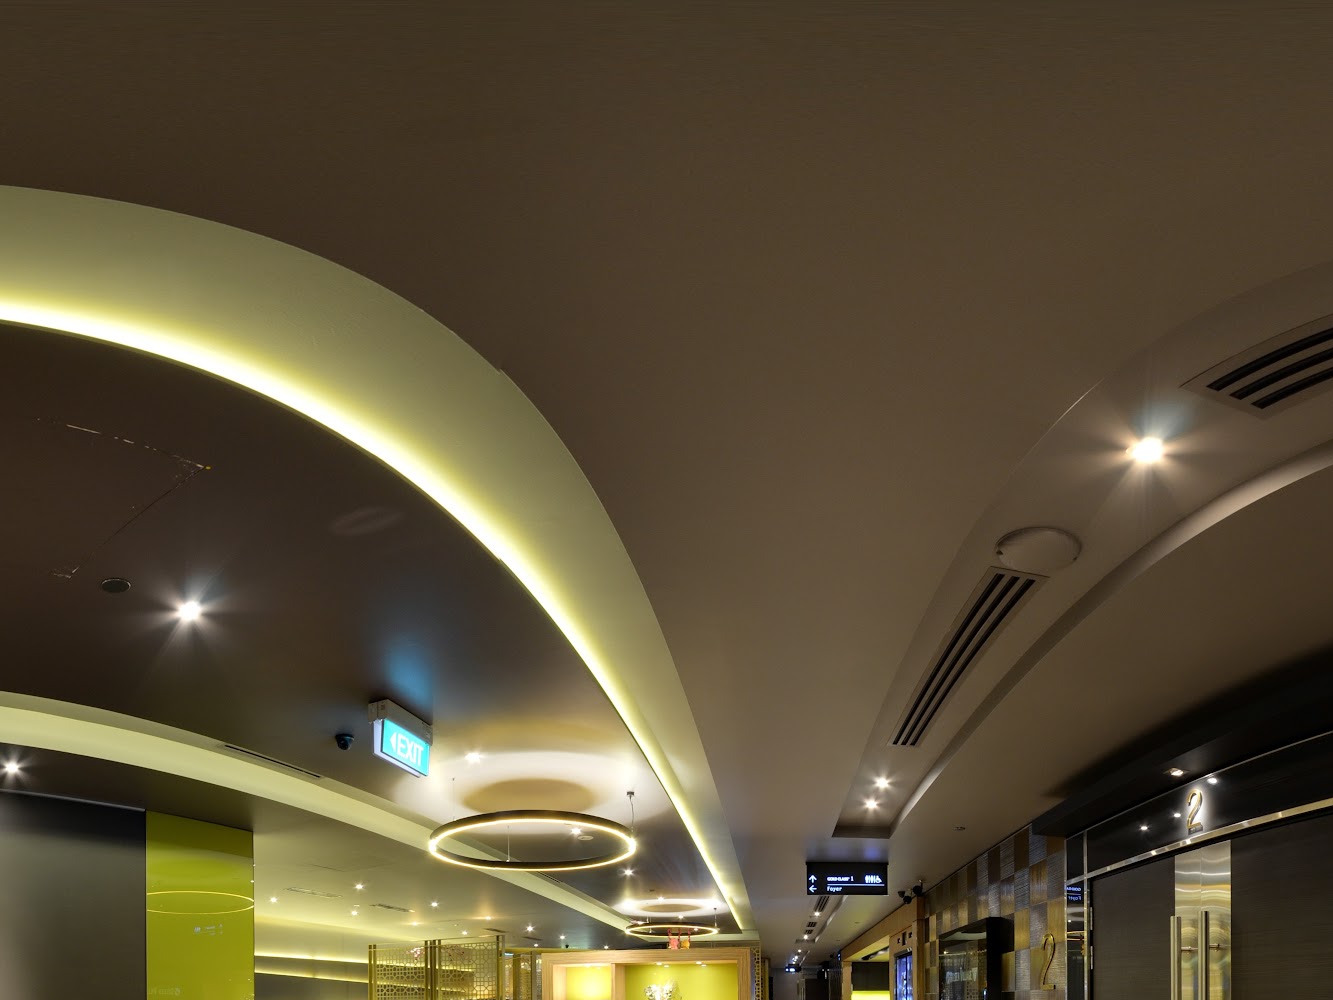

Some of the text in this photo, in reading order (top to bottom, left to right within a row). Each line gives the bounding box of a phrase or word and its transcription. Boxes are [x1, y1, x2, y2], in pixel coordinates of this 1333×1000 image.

[397, 732, 425, 767] EXIT
[1186, 789, 1203, 835] 2
[1040, 932, 1056, 991] 2
